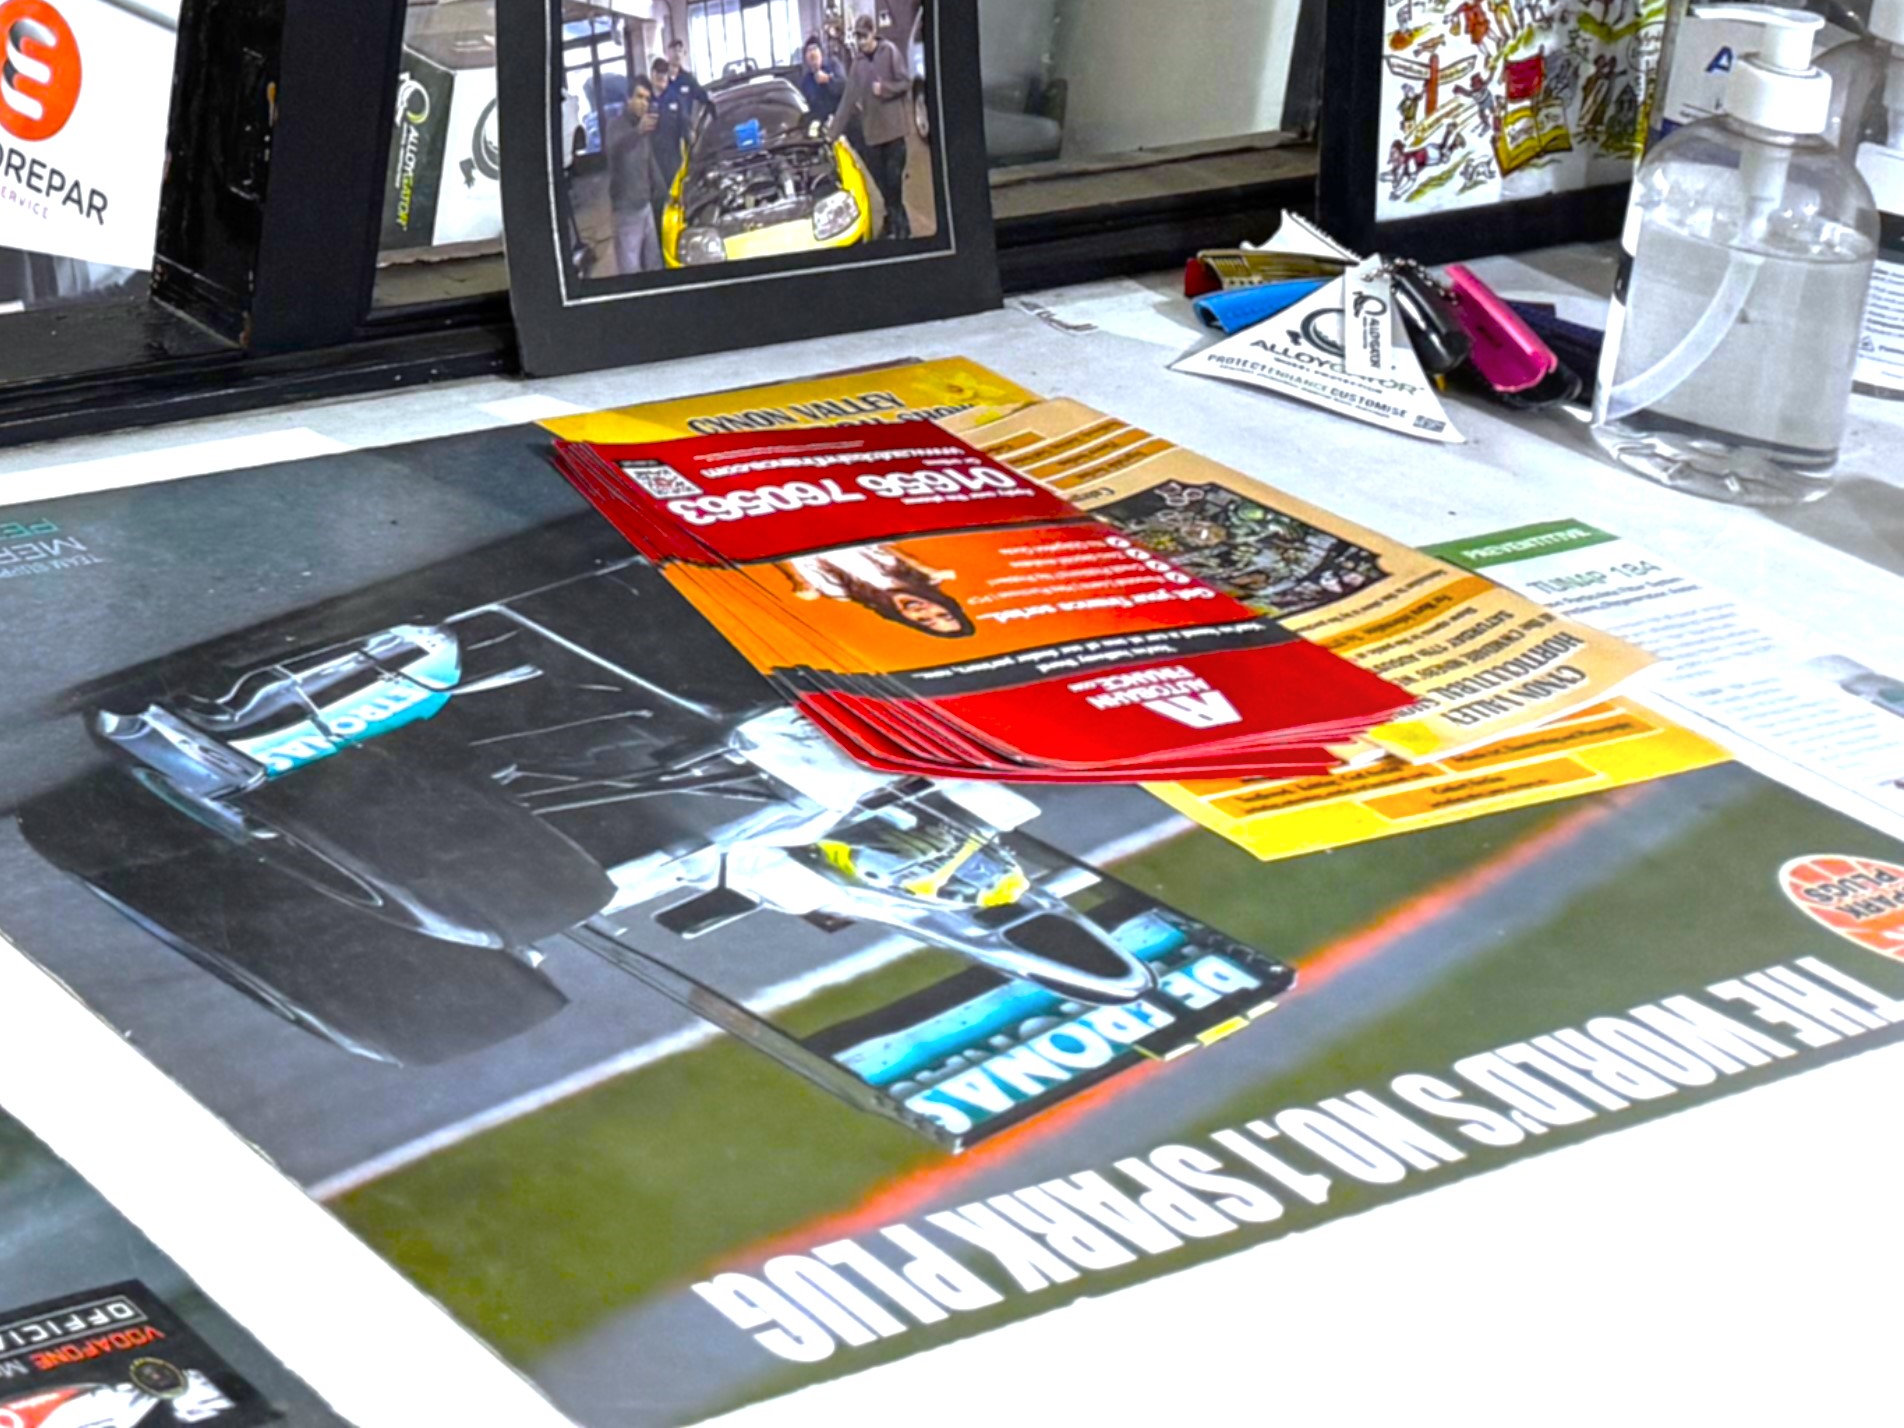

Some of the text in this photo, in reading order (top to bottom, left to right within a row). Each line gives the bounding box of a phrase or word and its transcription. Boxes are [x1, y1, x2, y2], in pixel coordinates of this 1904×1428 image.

[1207, 353, 1409, 419] PROTECT ENHANCE CUSTOMISE
[687, 401, 797, 436] CYNON
[636, 464, 1027, 526] 01656 760563
[1603, 557, 1666, 580] 184
[1049, 594, 1140, 614] finance
[1122, 588, 1179, 604] your
[1168, 586, 1221, 601] Get
[1054, 664, 1199, 693] FINANCE.com
[1429, 631, 1586, 704] HORTICULTURAL
[1072, 676, 1225, 710] AUTOBAHN
[1440, 662, 1588, 729] CYNON VALLEY
[1802, 868, 1898, 904] PLUGS
[693, 956, 1904, 1362] THE WORLD'S NO.1 SPARK PLUG
[32, 1322, 163, 1370] VODAFONE
